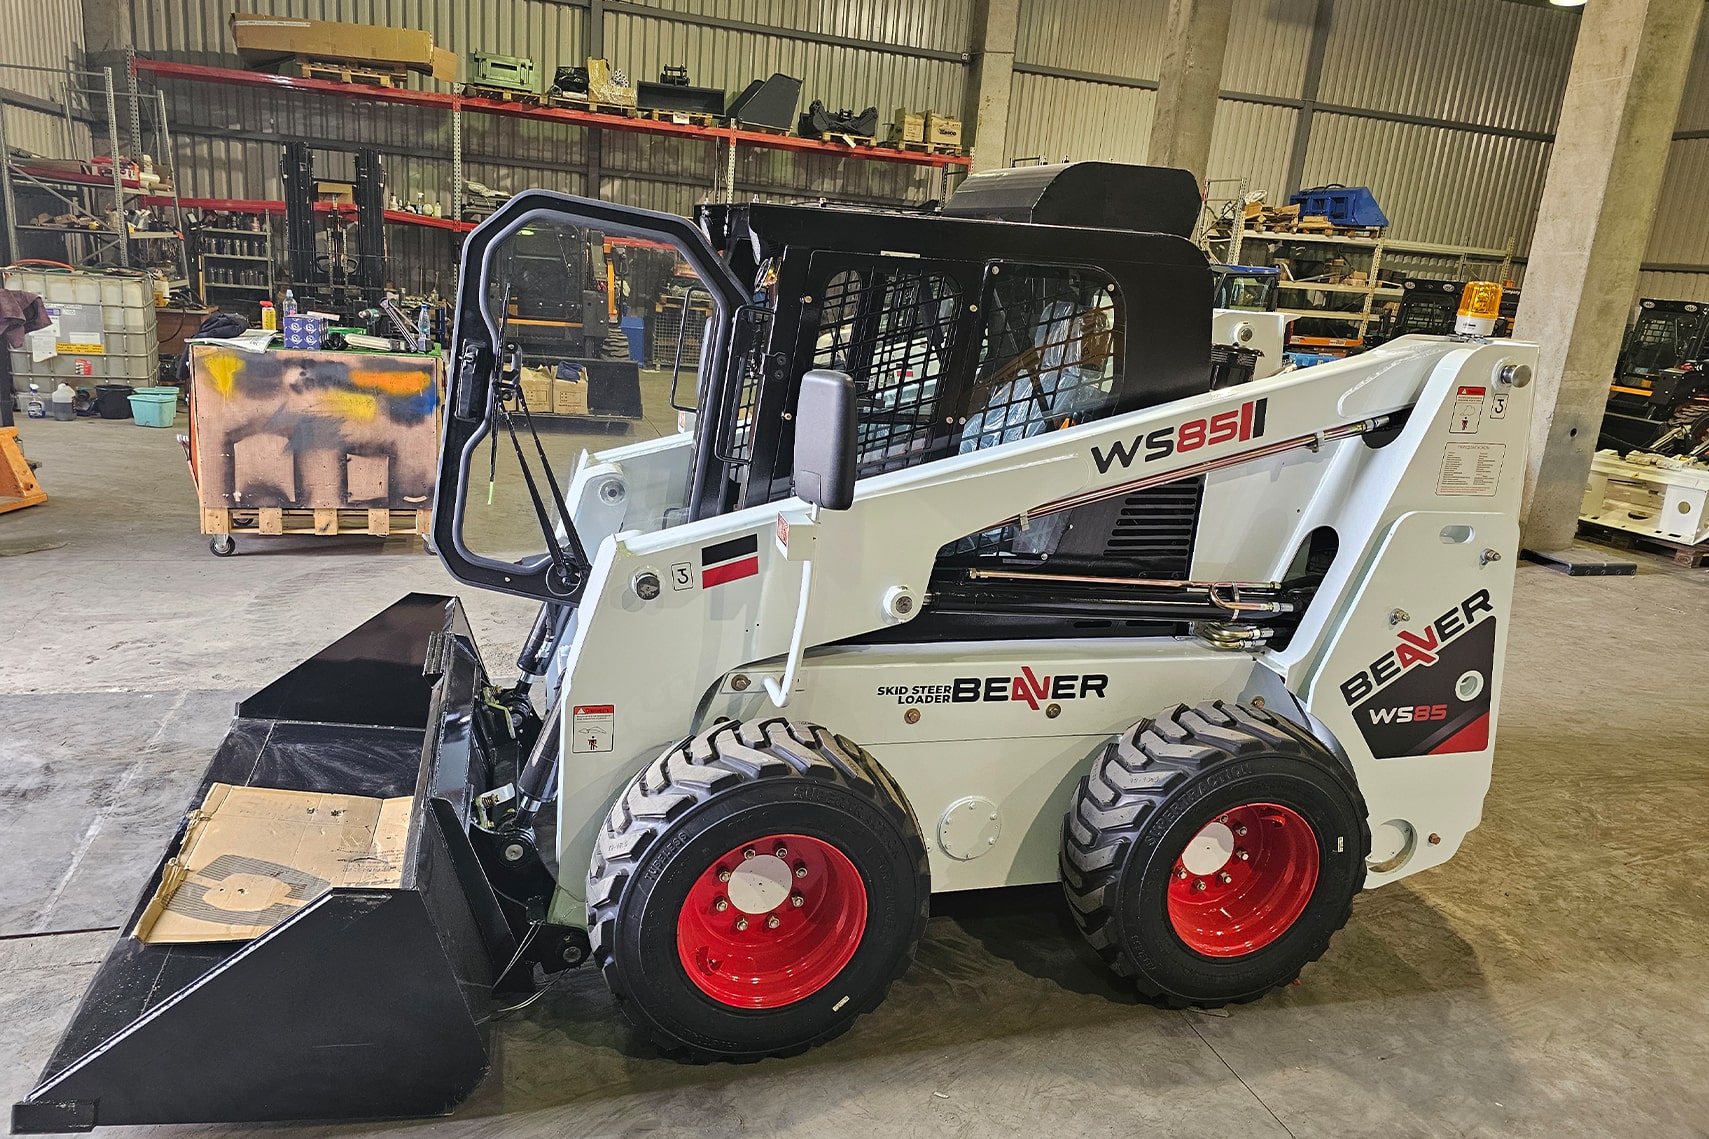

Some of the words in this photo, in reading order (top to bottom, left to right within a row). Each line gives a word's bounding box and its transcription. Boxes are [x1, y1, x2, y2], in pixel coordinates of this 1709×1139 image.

[1339, 588, 1494, 707] BEAVER
[877, 686, 908, 696] SKID
[911, 685, 952, 695] STEER
[951, 666, 1109, 711] BEAVER
[897, 695, 951, 705] LOADER
[1368, 704, 1448, 725] WS85
